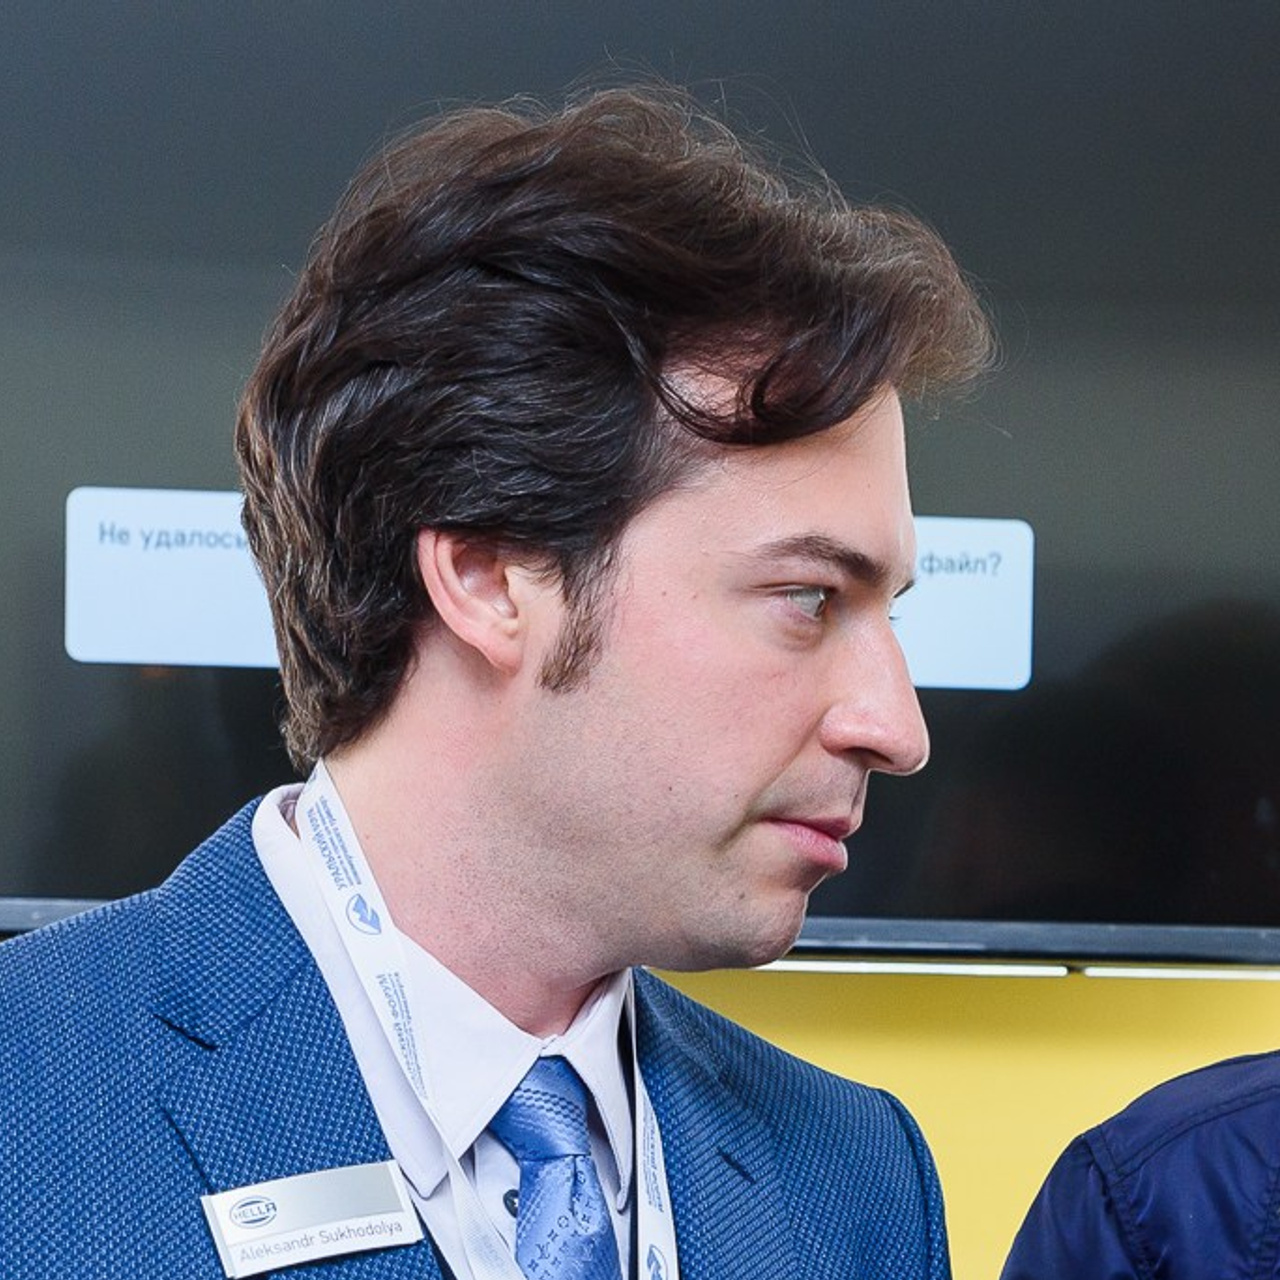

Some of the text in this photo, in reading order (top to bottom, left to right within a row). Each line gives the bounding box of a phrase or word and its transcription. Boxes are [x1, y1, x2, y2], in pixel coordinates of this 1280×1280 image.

[99, 524, 247, 552] Не удалось
[920, 552, 1002, 578] файл?
[234, 1203, 277, 1220] HELLA
[240, 1222, 403, 1262] Aleksandr Sukhodolya
